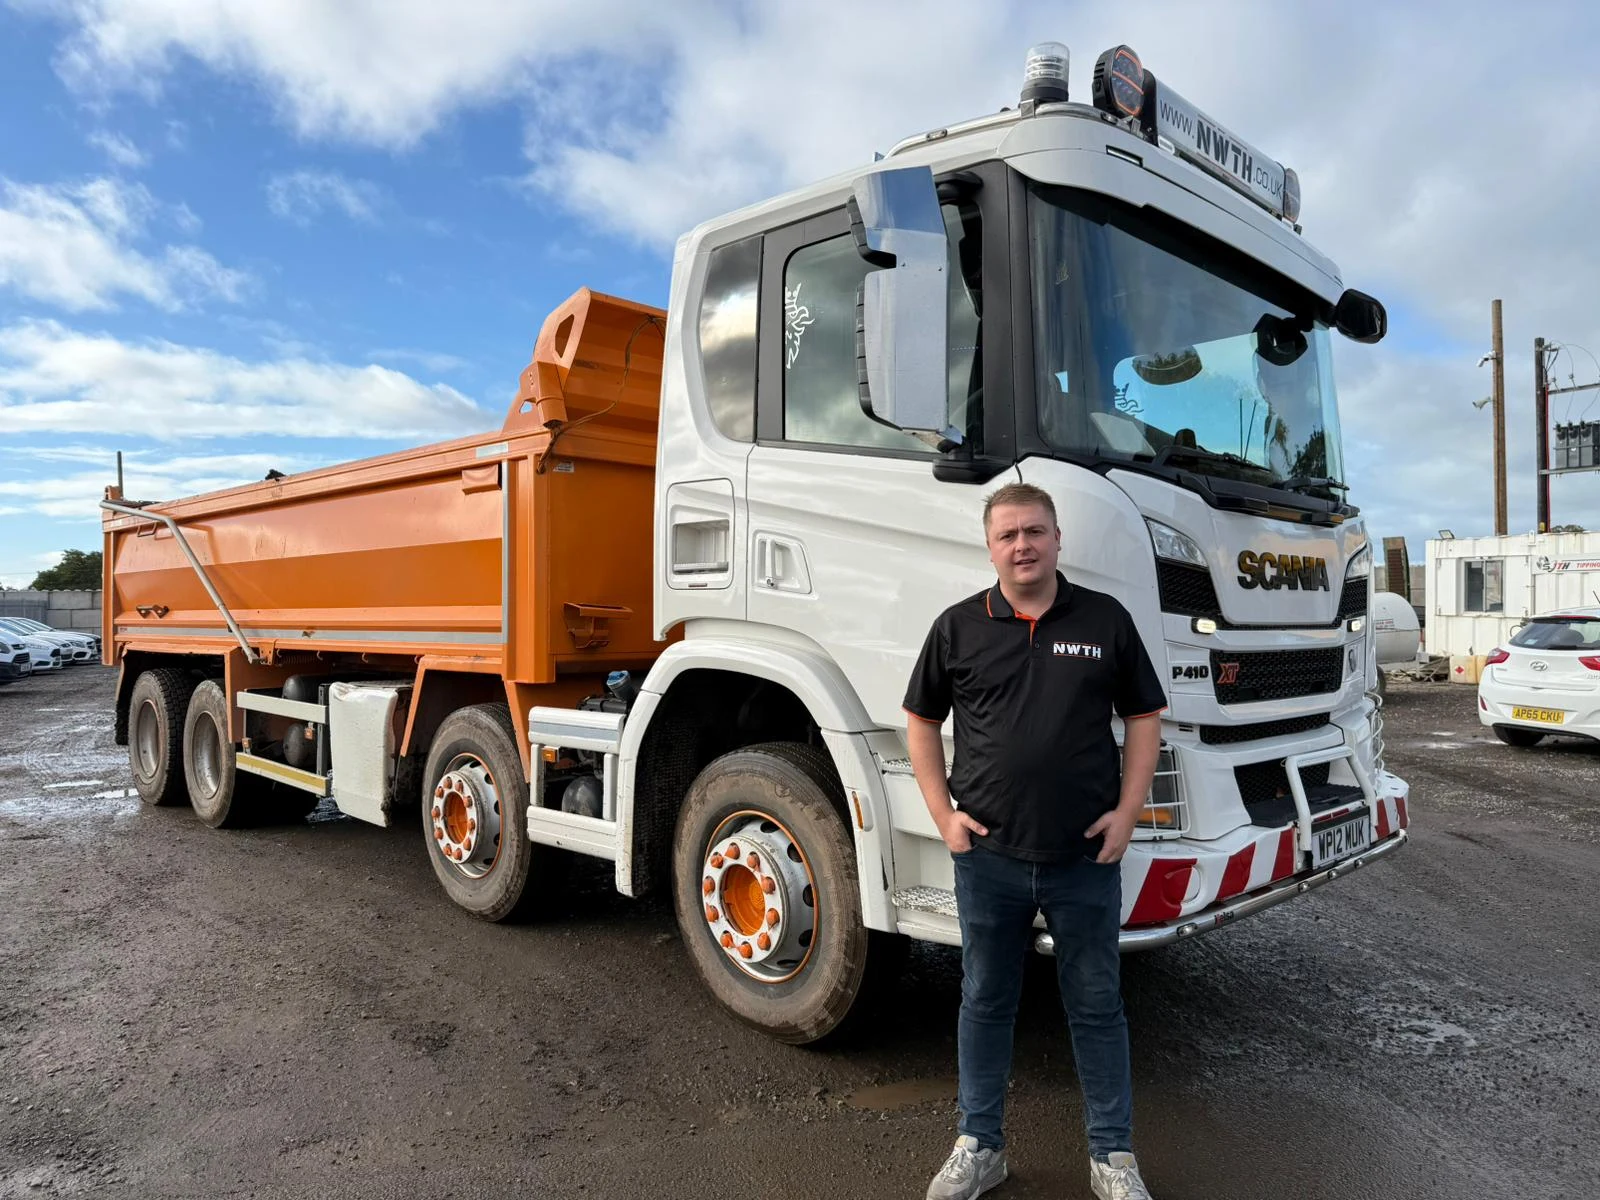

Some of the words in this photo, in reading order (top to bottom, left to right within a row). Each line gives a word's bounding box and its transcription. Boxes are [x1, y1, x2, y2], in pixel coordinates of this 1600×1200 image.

[1237, 549, 1330, 592] SCANIA
[1053, 643, 1102, 659] NWTH
[1172, 665, 1209, 680] P410
[1217, 662, 1240, 684] XT
[1515, 708, 1538, 720] AP65
[1318, 827, 1343, 861] WP12
[1344, 818, 1365, 851] MUK
